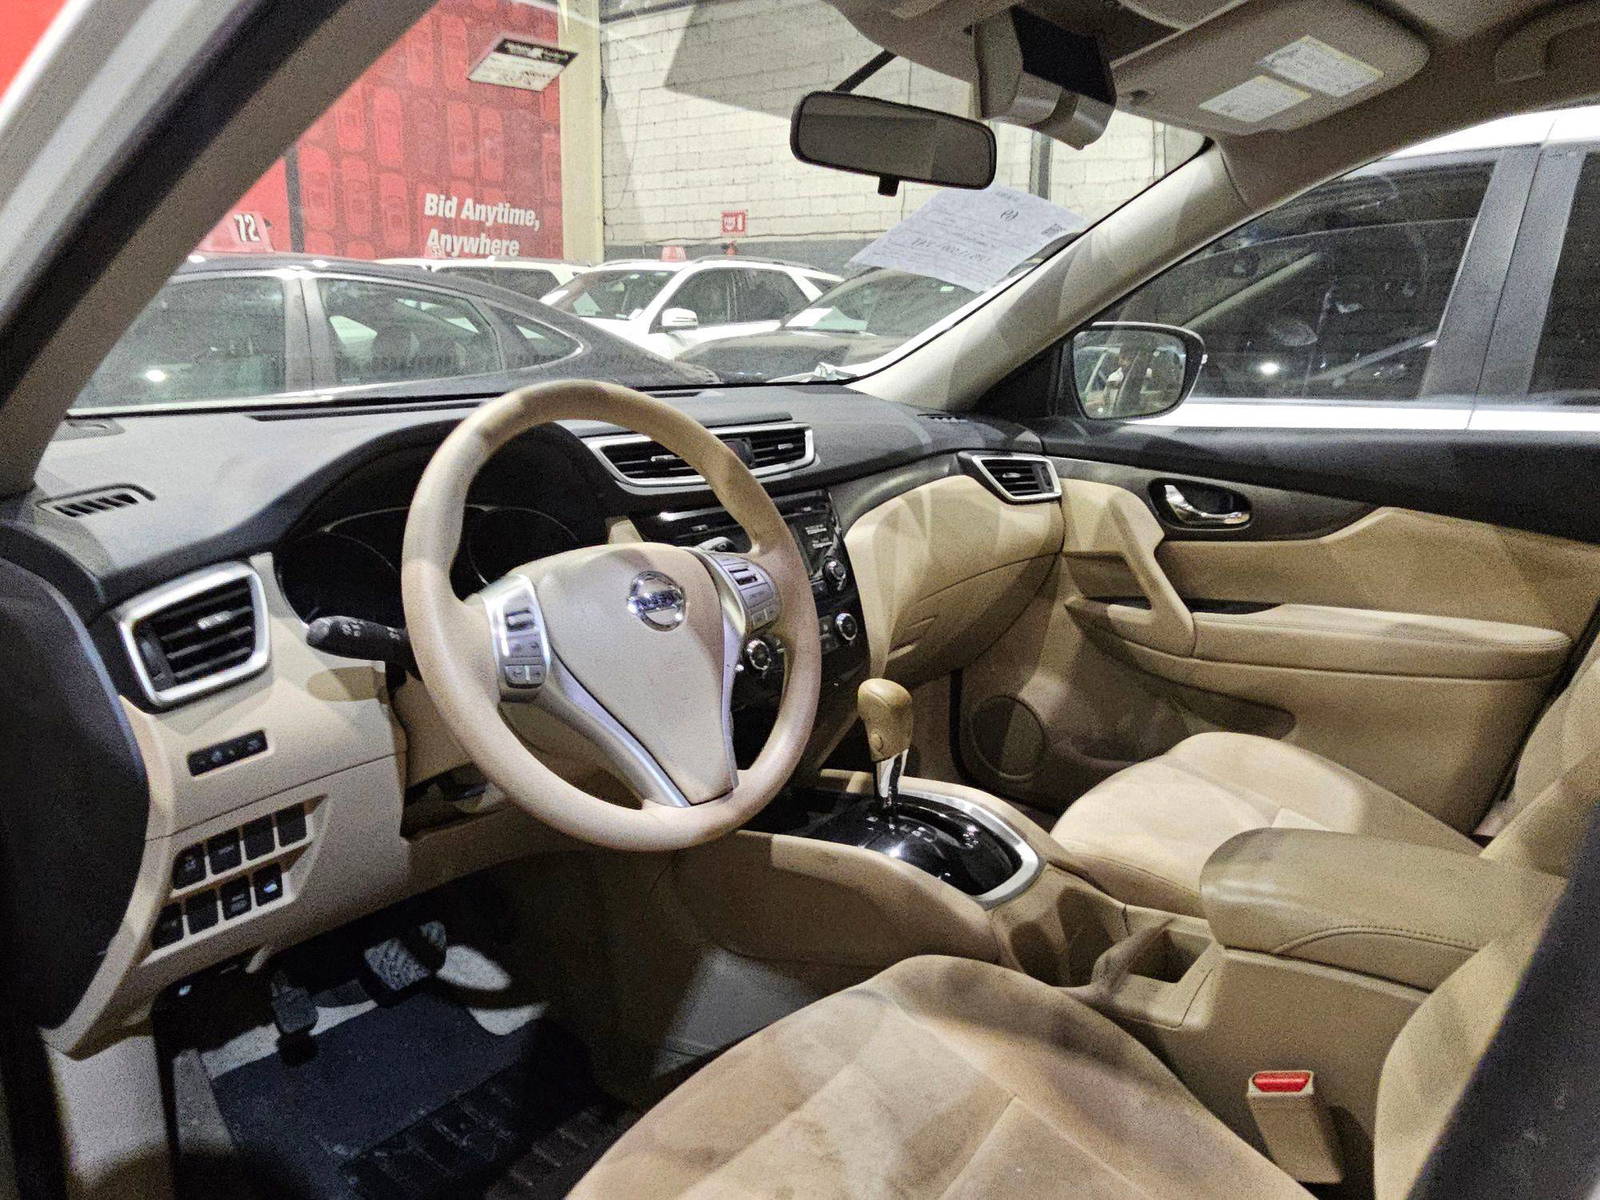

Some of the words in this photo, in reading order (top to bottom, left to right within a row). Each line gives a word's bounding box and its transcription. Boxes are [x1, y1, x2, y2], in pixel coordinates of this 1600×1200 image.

[424, 193, 458, 219] Bid
[460, 198, 540, 232] Anytime,
[233, 213, 261, 242] 72
[427, 228, 520, 257] Anywhere
